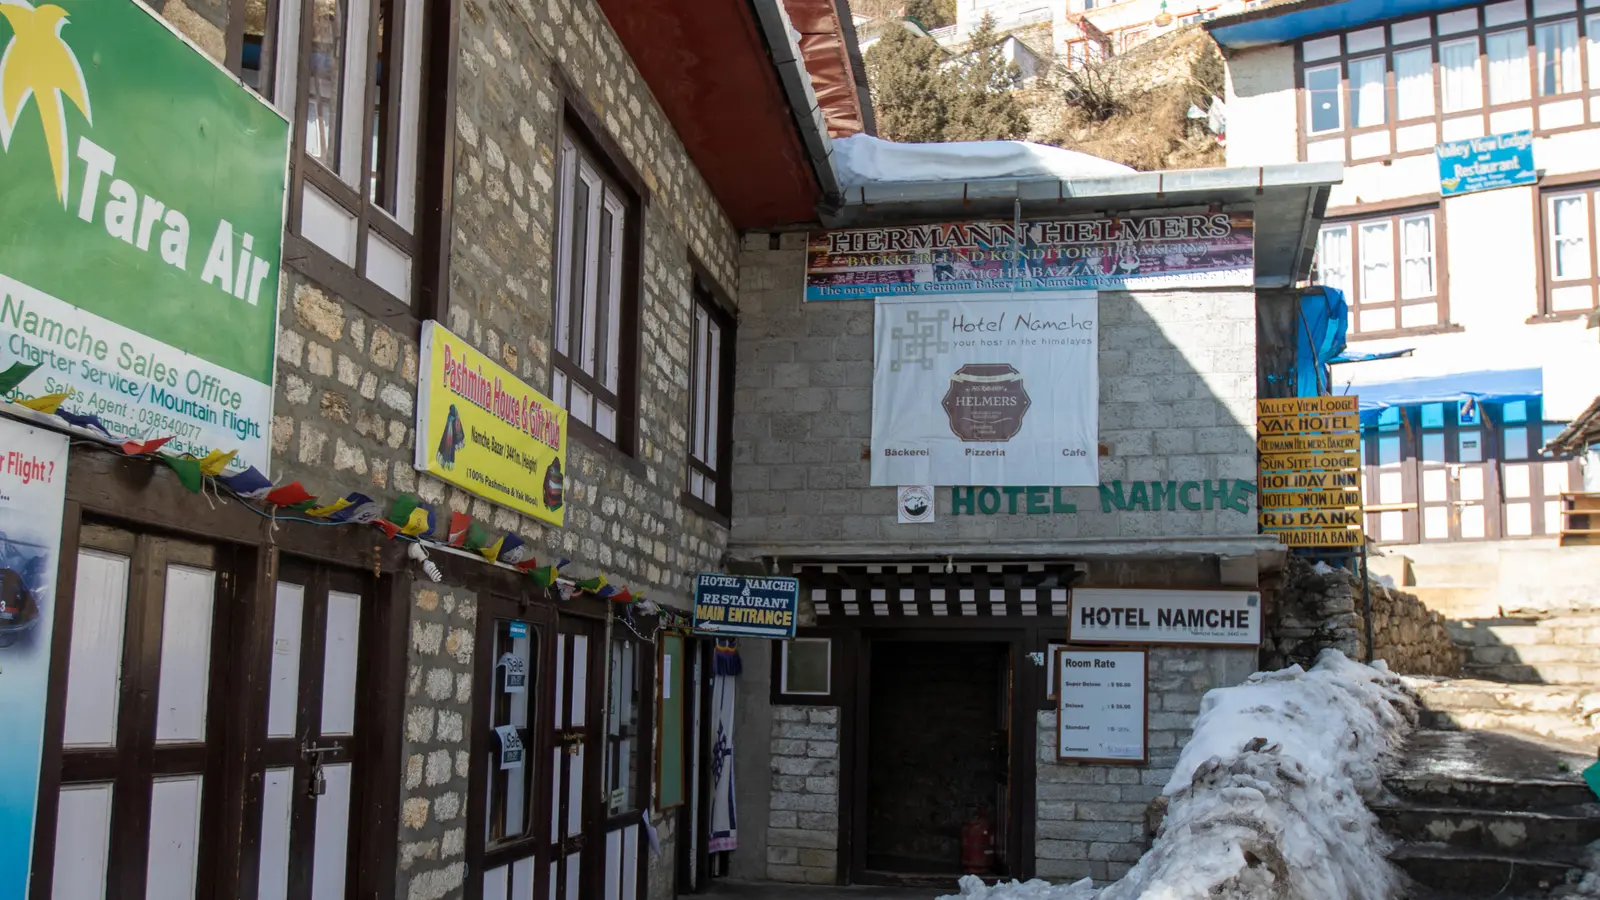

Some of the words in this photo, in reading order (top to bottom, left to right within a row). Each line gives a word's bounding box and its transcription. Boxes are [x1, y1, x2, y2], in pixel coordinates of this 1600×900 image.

[1470, 139, 1497, 153] View
[1454, 156, 1519, 178] Restaurant
[77, 135, 190, 271] Tara
[201, 219, 270, 306] Air
[828, 222, 1028, 254] HERMANN
[1035, 213, 1232, 245] HELMERS
[819, 286, 841, 296] The
[844, 286, 865, 295] one
[869, 284, 890, 293] and
[893, 283, 919, 294] only
[924, 281, 970, 291] German
[1020, 278, 1032, 288] in
[1036, 276, 1088, 287] Namche
[1092, 277, 1103, 286] at
[952, 312, 1005, 333] Hotel
[1014, 312, 1093, 331] Namche
[1, 293, 108, 360] Namche
[117, 342, 178, 387] Sales
[185, 369, 242, 410] Office
[953, 340, 975, 349] your
[980, 338, 1003, 347] host
[1007, 338, 1016, 346] in
[1021, 338, 1036, 346] the
[9, 334, 76, 374] Charter
[222, 409, 261, 440] Flight
[443, 344, 491, 414] Pashmina
[493, 376, 521, 429] House
[521, 395, 529, 435] &
[530, 401, 544, 443] Gift
[545, 409, 560, 450] Hub
[955, 396, 1017, 406] HELMERS
[1259, 402, 1295, 414] VALLEY
[1297, 400, 1319, 412] VIEW
[1319, 399, 1353, 411] LODGE
[88, 392, 127, 417] Agent
[138, 408, 202, 440] 038540077
[1261, 419, 1295, 432] YAK
[1299, 416, 1353, 430] HOTEL
[1327, 436, 1354, 449] BAKERY
[965, 448, 1006, 457] Pizzeria
[1062, 448, 1086, 457] Cafe
[1261, 456, 1285, 470] SUN
[1287, 456, 1311, 469] SITE
[1313, 455, 1354, 468] LODGE
[485, 475, 510, 495] Pashmina
[1262, 474, 1328, 489] HOLIDAY
[1332, 472, 1356, 486] INN
[951, 485, 1077, 515] HOTEL
[1098, 478, 1258, 514] NAMCHE
[1262, 493, 1295, 507] HOTEL
[1298, 492, 1327, 506] SNOW
[1330, 492, 1358, 505] LAND
[1263, 512, 1277, 526] R
[1281, 512, 1295, 526] B
[1299, 511, 1358, 525] BANK
[1331, 530, 1359, 544] BANK
[700, 575, 740, 588] HOTEL
[745, 579, 796, 592] NAMCHE
[702, 593, 789, 608] RESTAURANT
[696, 604, 725, 621] MAIN
[727, 606, 793, 626] ENTRANCE
[1081, 606, 1150, 627] HOTEL
[1157, 608, 1250, 629] NAMCHE
[507, 657, 523, 673] Sale
[1065, 658, 1091, 668] Room
[1094, 658, 1116, 668] Rate
[506, 732, 520, 749] Sale
